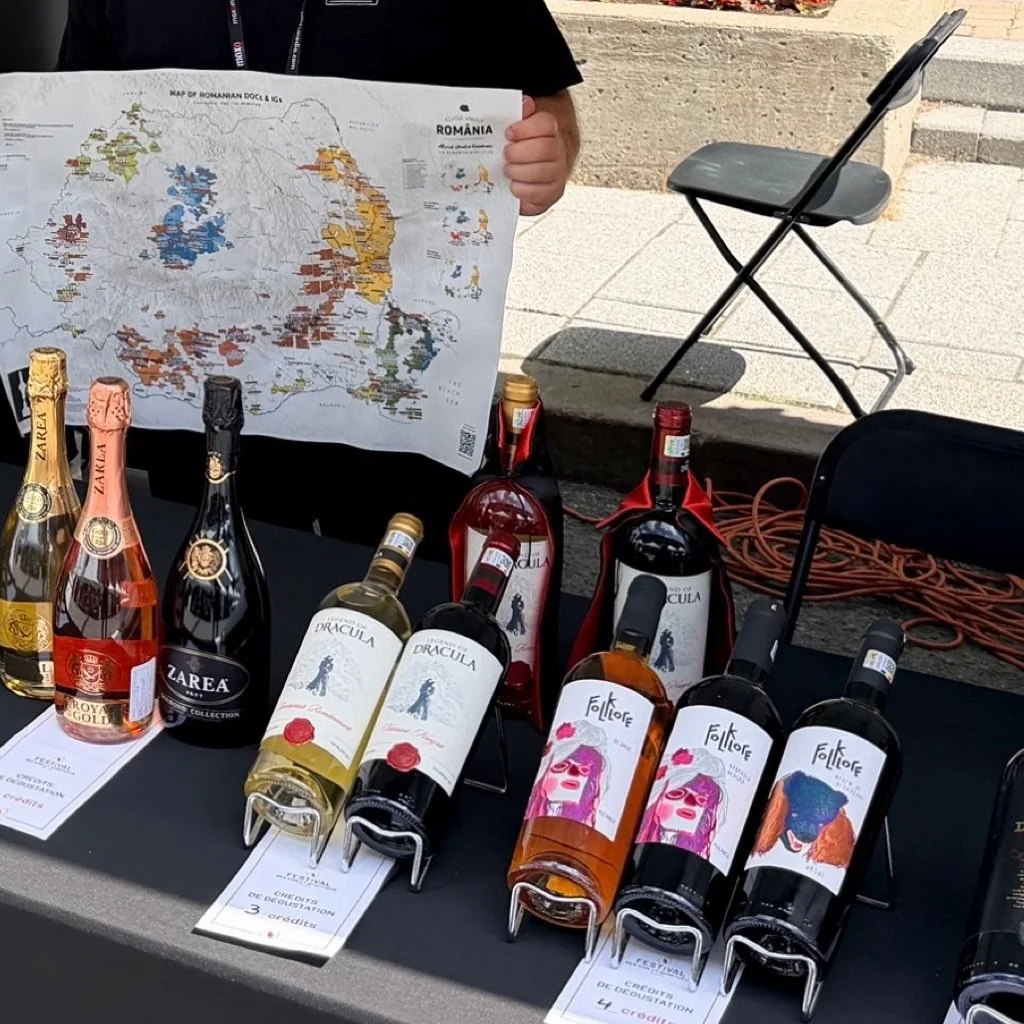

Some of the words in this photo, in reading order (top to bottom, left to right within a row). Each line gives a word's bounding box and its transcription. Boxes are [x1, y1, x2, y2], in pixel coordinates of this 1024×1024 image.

[169, 89, 186, 97] MAP
[188, 90, 198, 98] OF
[199, 90, 242, 100] ROMANIAN
[435, 123, 494, 137] ROMÂNIA
[35, 411, 48, 462] ZAREA
[93, 443, 107, 495] ZAREA
[667, 592, 701, 605] CULA
[314, 621, 375, 648] DRACULA
[413, 643, 477, 672] DRACULA
[167, 664, 230, 694] ZAREA
[72, 699, 109, 715] ROYA
[190, 708, 241, 720] COLLECTION
[72, 711, 110, 725] GOLD
[286, 872, 330, 888] FESTIVAL
[247, 891, 261, 900] DE
[243, 904, 260, 916] 3
[267, 913, 318, 929] crédits
[636, 958, 686, 978] FESTIVAL
[596, 980, 612, 991] DE
[597, 997, 613, 1010] 4
